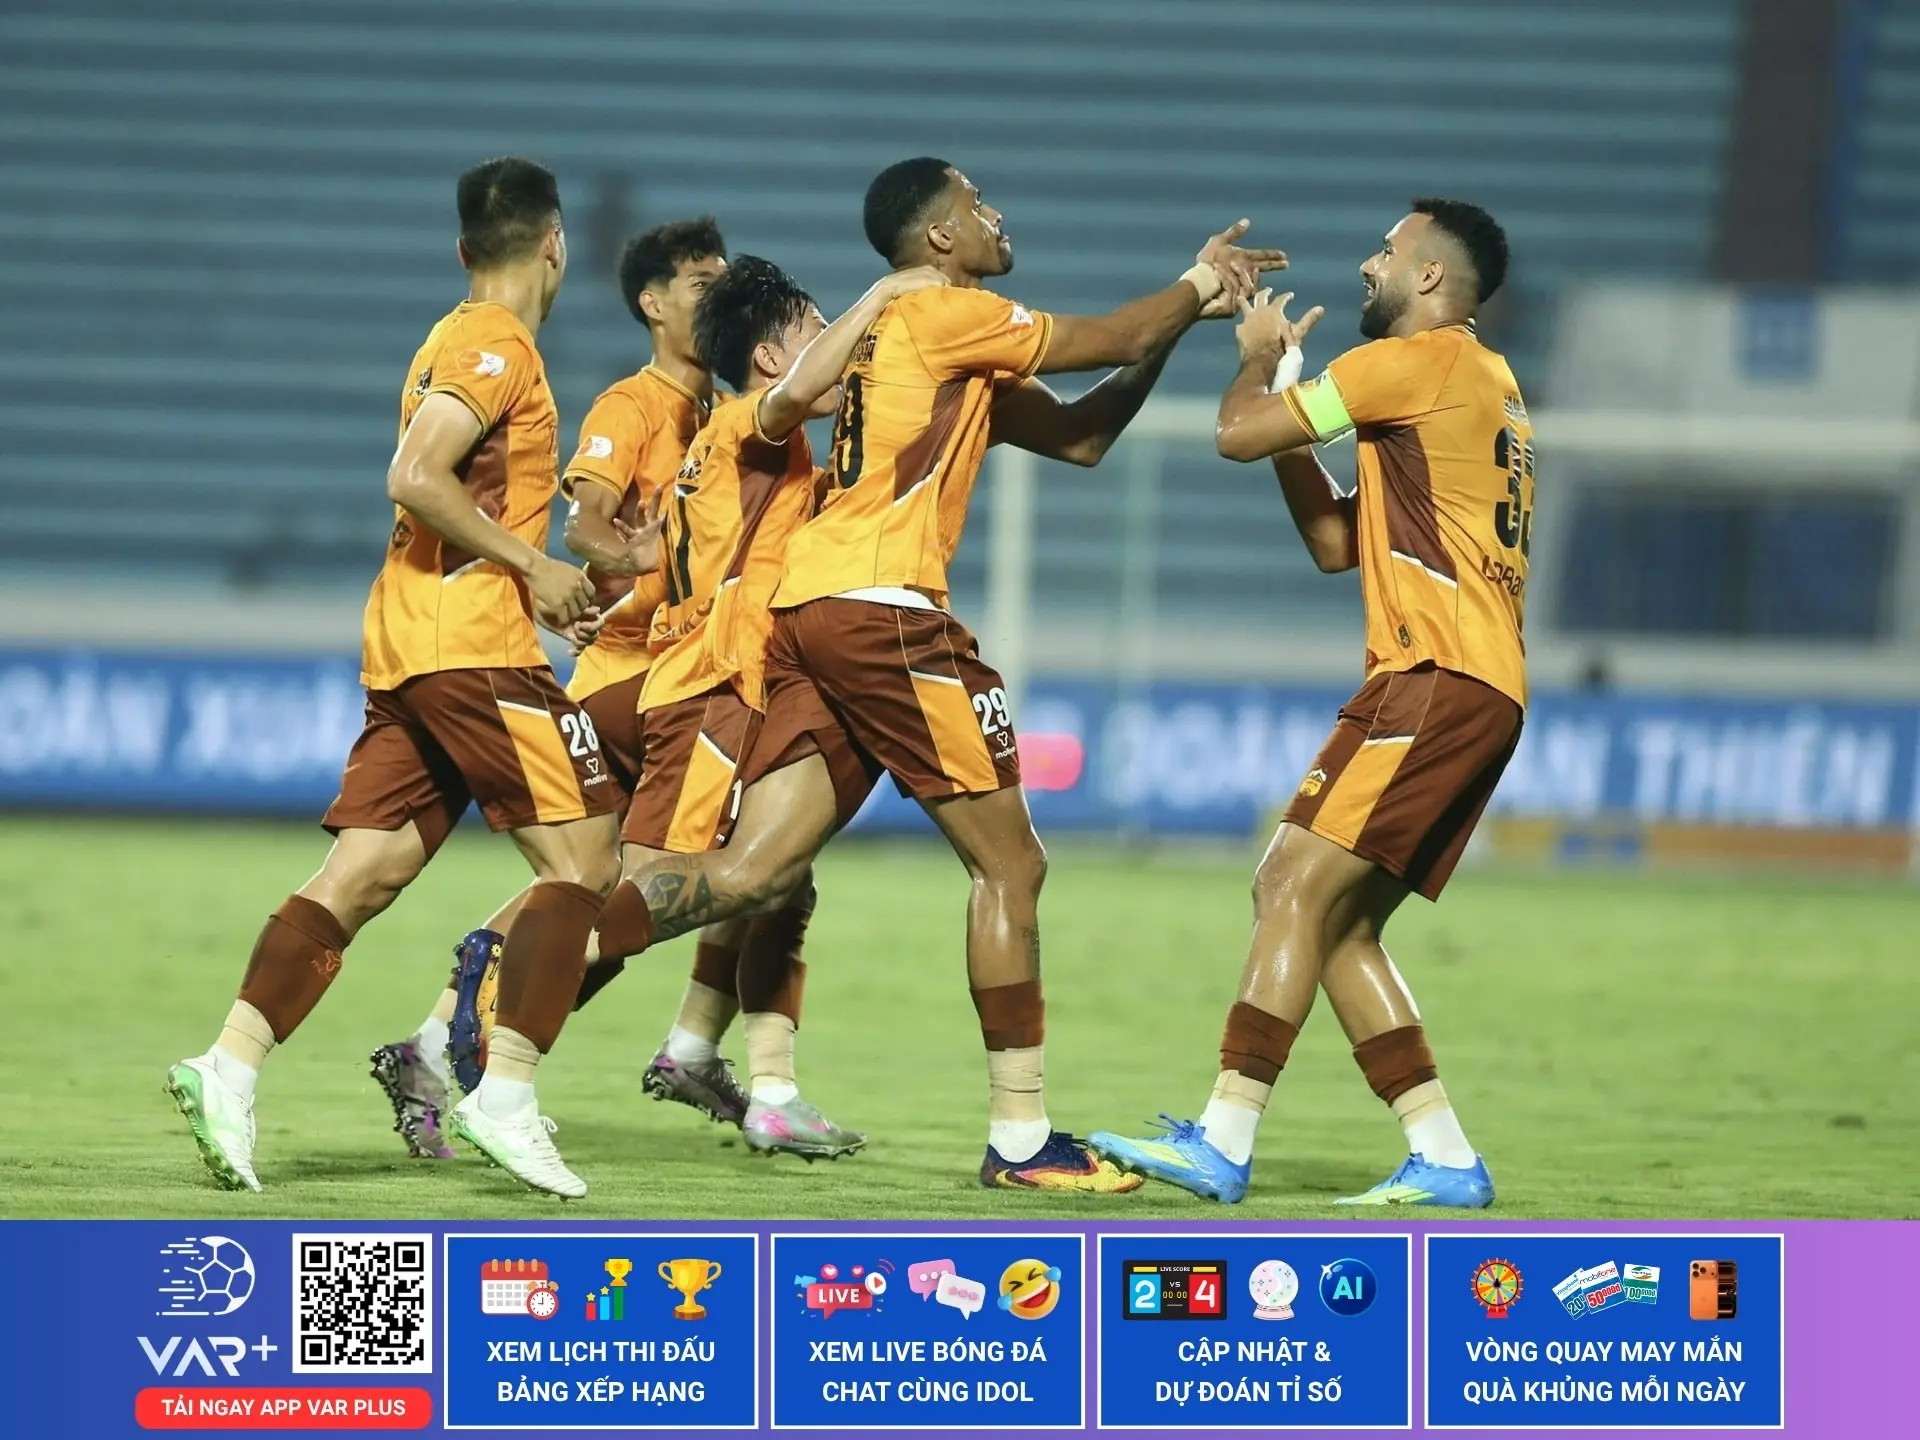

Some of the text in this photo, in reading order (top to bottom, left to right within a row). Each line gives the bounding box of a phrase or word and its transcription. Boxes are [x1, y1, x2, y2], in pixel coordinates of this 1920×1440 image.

[830, 371, 864, 489] 9
[560, 708, 599, 757] 28
[972, 687, 1011, 736] 29
